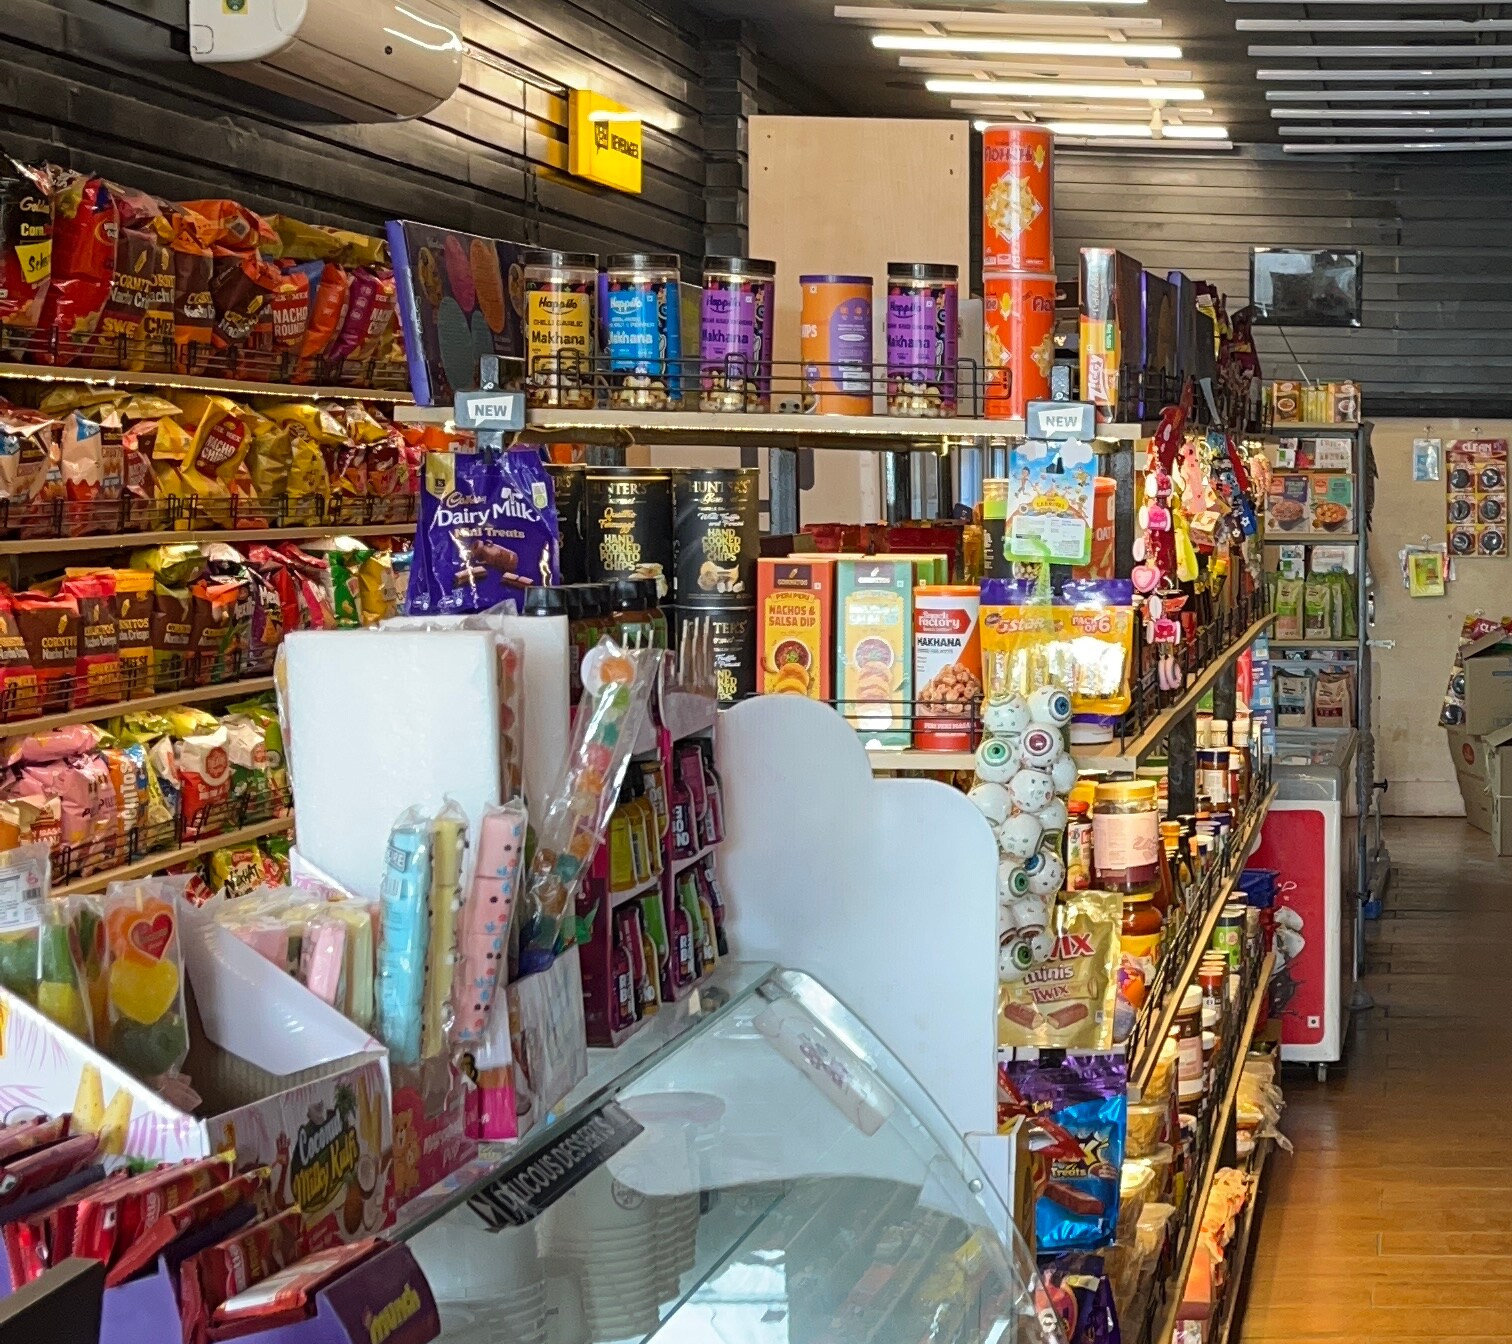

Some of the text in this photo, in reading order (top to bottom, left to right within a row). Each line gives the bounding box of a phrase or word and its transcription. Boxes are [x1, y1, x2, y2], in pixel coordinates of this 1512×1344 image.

[532, 331, 585, 346] Makhana
[475, 404, 507, 416] NEW
[1046, 416, 1077, 427] NEW
[437, 500, 536, 526] Dairy Milk
[484, 527, 525, 539] Treats
[603, 534, 634, 544] HAND
[707, 529, 736, 538] HAND
[702, 537, 741, 546] COOKED
[600, 543, 641, 553] COOKED
[702, 544, 740, 554] POTATO
[600, 551, 641, 562] POTATO
[707, 552, 736, 562] CHIPS
[603, 561, 636, 571] CHIPS
[768, 605, 816, 616] NACHOS &
[712, 621, 747, 635] TER'S
[768, 616, 816, 628] SALSA DIP
[918, 617, 960, 629] Factory
[1099, 616, 1111, 633] 6
[917, 637, 962, 648] MAKHANA
[1023, 965, 1074, 985] minis
[1029, 983, 1069, 1002] TWIX
[301, 1111, 343, 1164] Coconut
[295, 1160, 330, 1207] Milky
